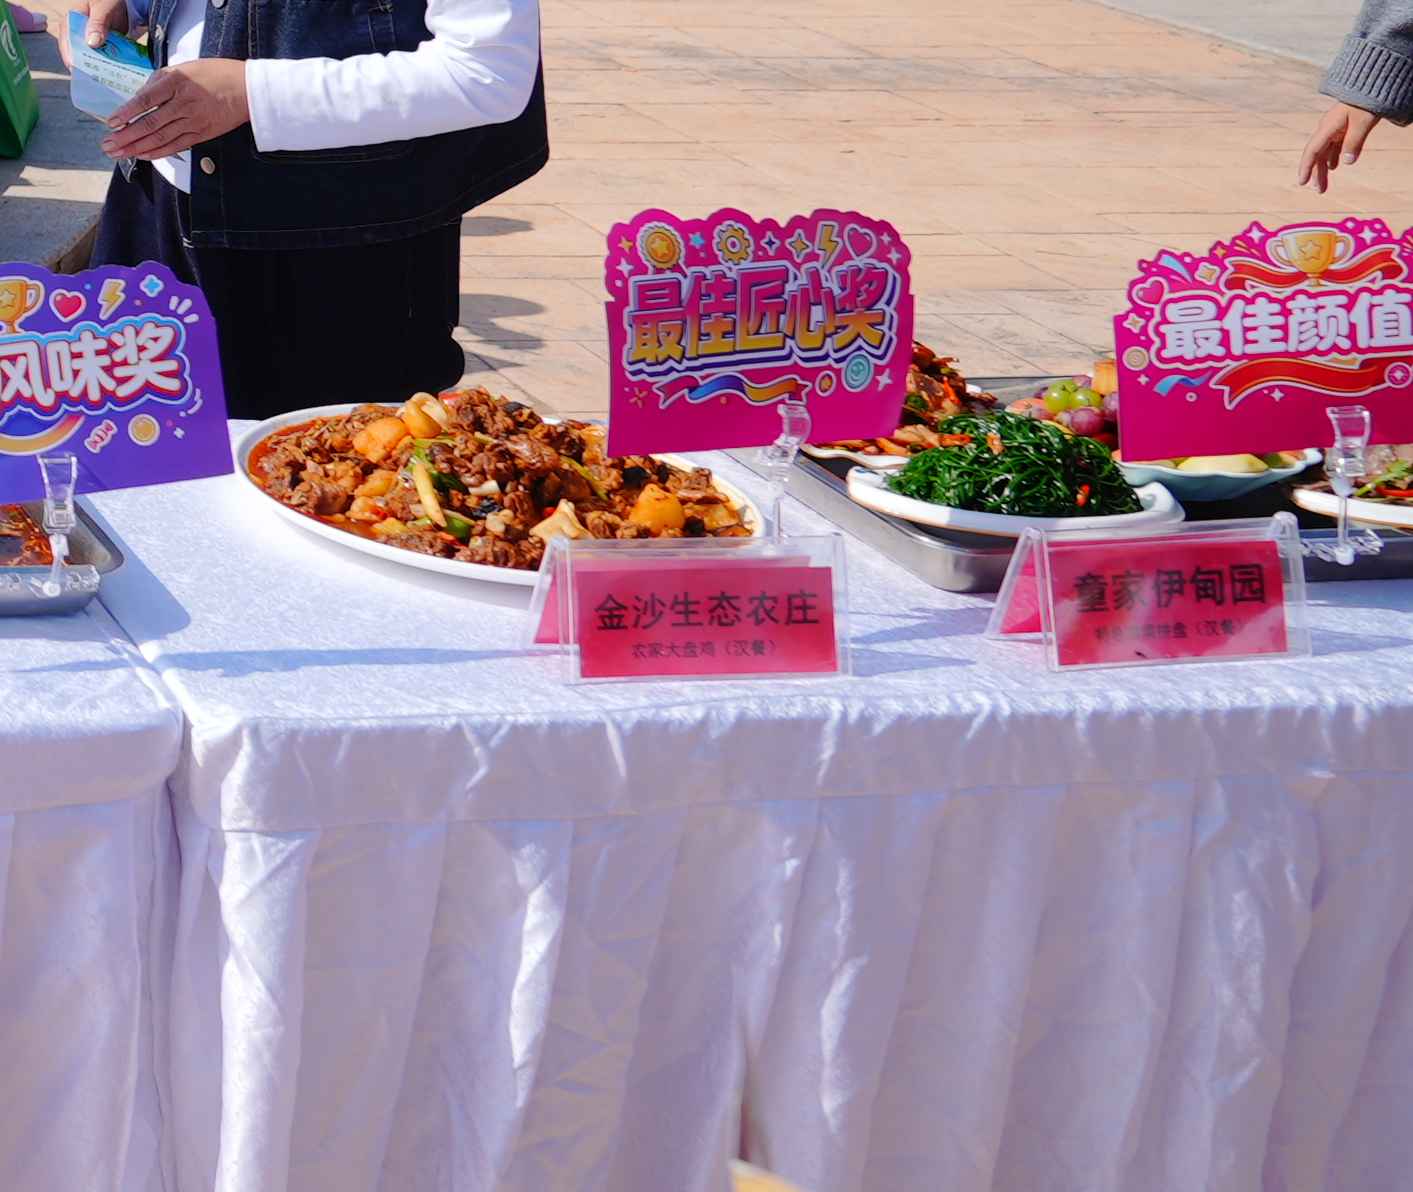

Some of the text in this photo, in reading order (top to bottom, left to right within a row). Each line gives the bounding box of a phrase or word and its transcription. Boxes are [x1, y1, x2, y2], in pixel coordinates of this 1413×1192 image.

[629, 264, 890, 364] 最佳匠心奖
[1158, 289, 1413, 360] 最佳颜值
[594, 589, 821, 632] 金沙生态农庄
[1073, 563, 1267, 613] 童家伊甸园
